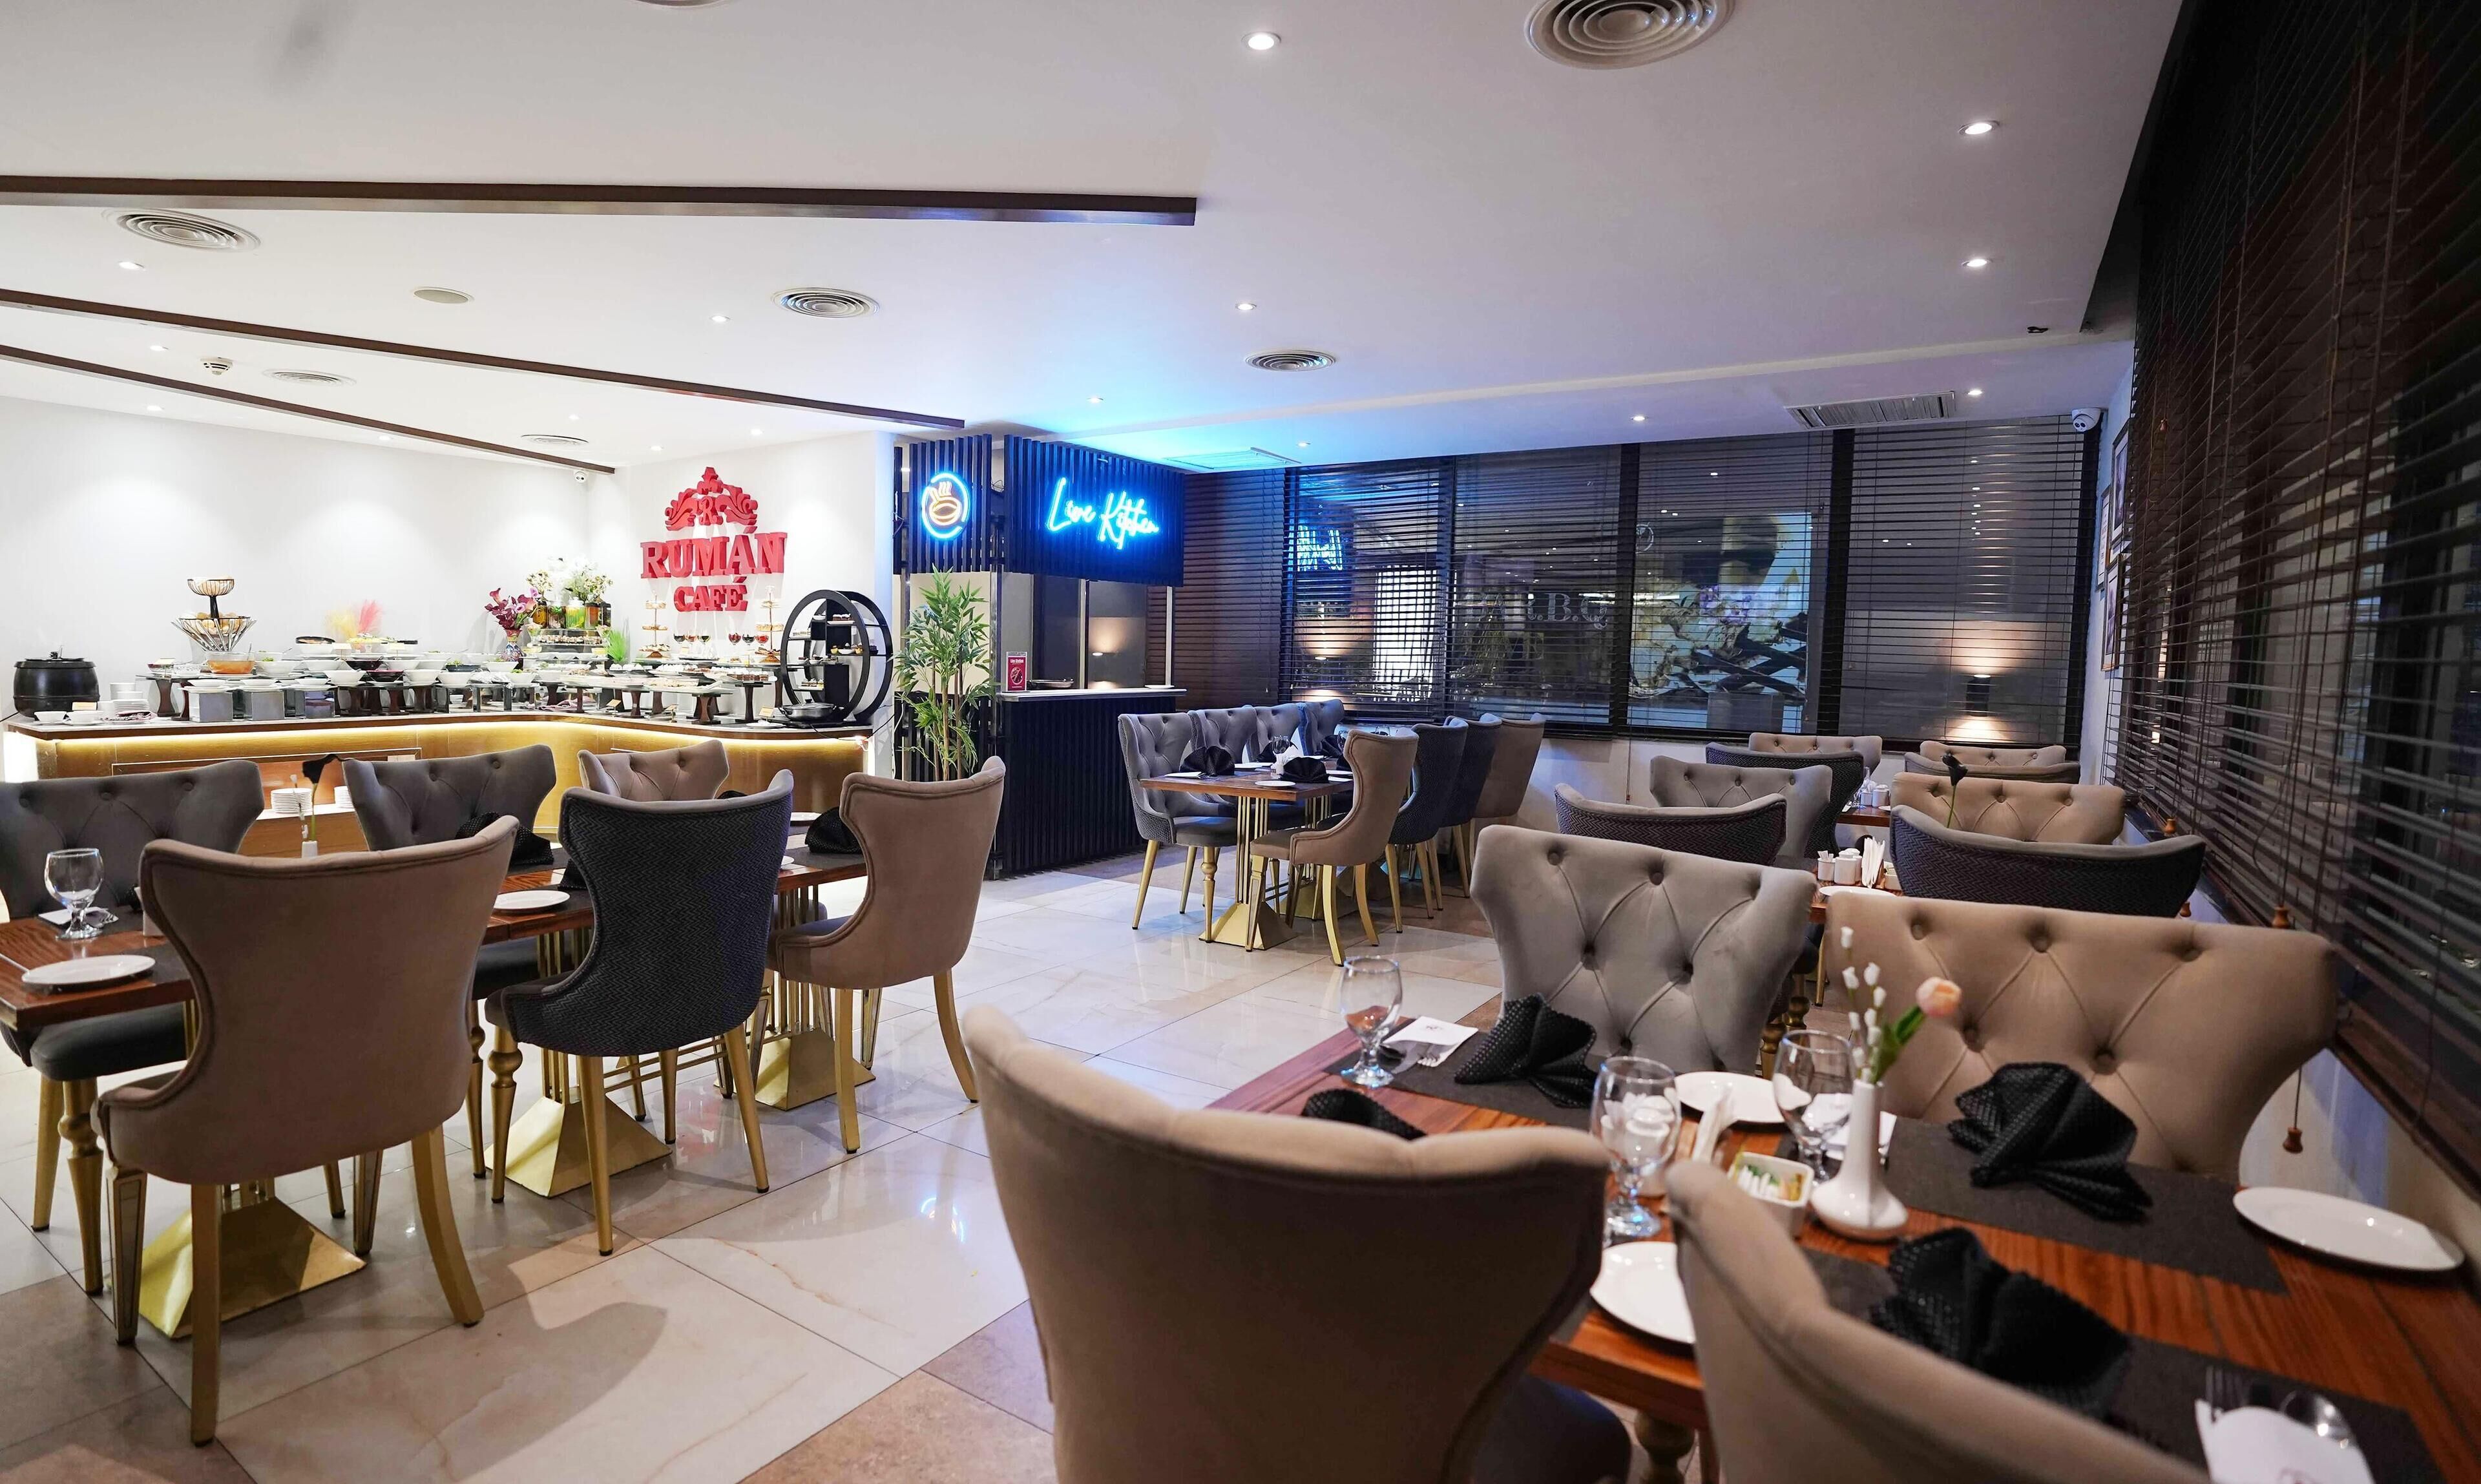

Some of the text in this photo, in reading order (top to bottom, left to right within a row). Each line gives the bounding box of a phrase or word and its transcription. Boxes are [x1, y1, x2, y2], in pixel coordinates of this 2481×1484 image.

[1047, 477, 1159, 550] Live Kitchen
[640, 526, 788, 579] RUMÁN
[674, 576, 748, 612] CAFÉ
